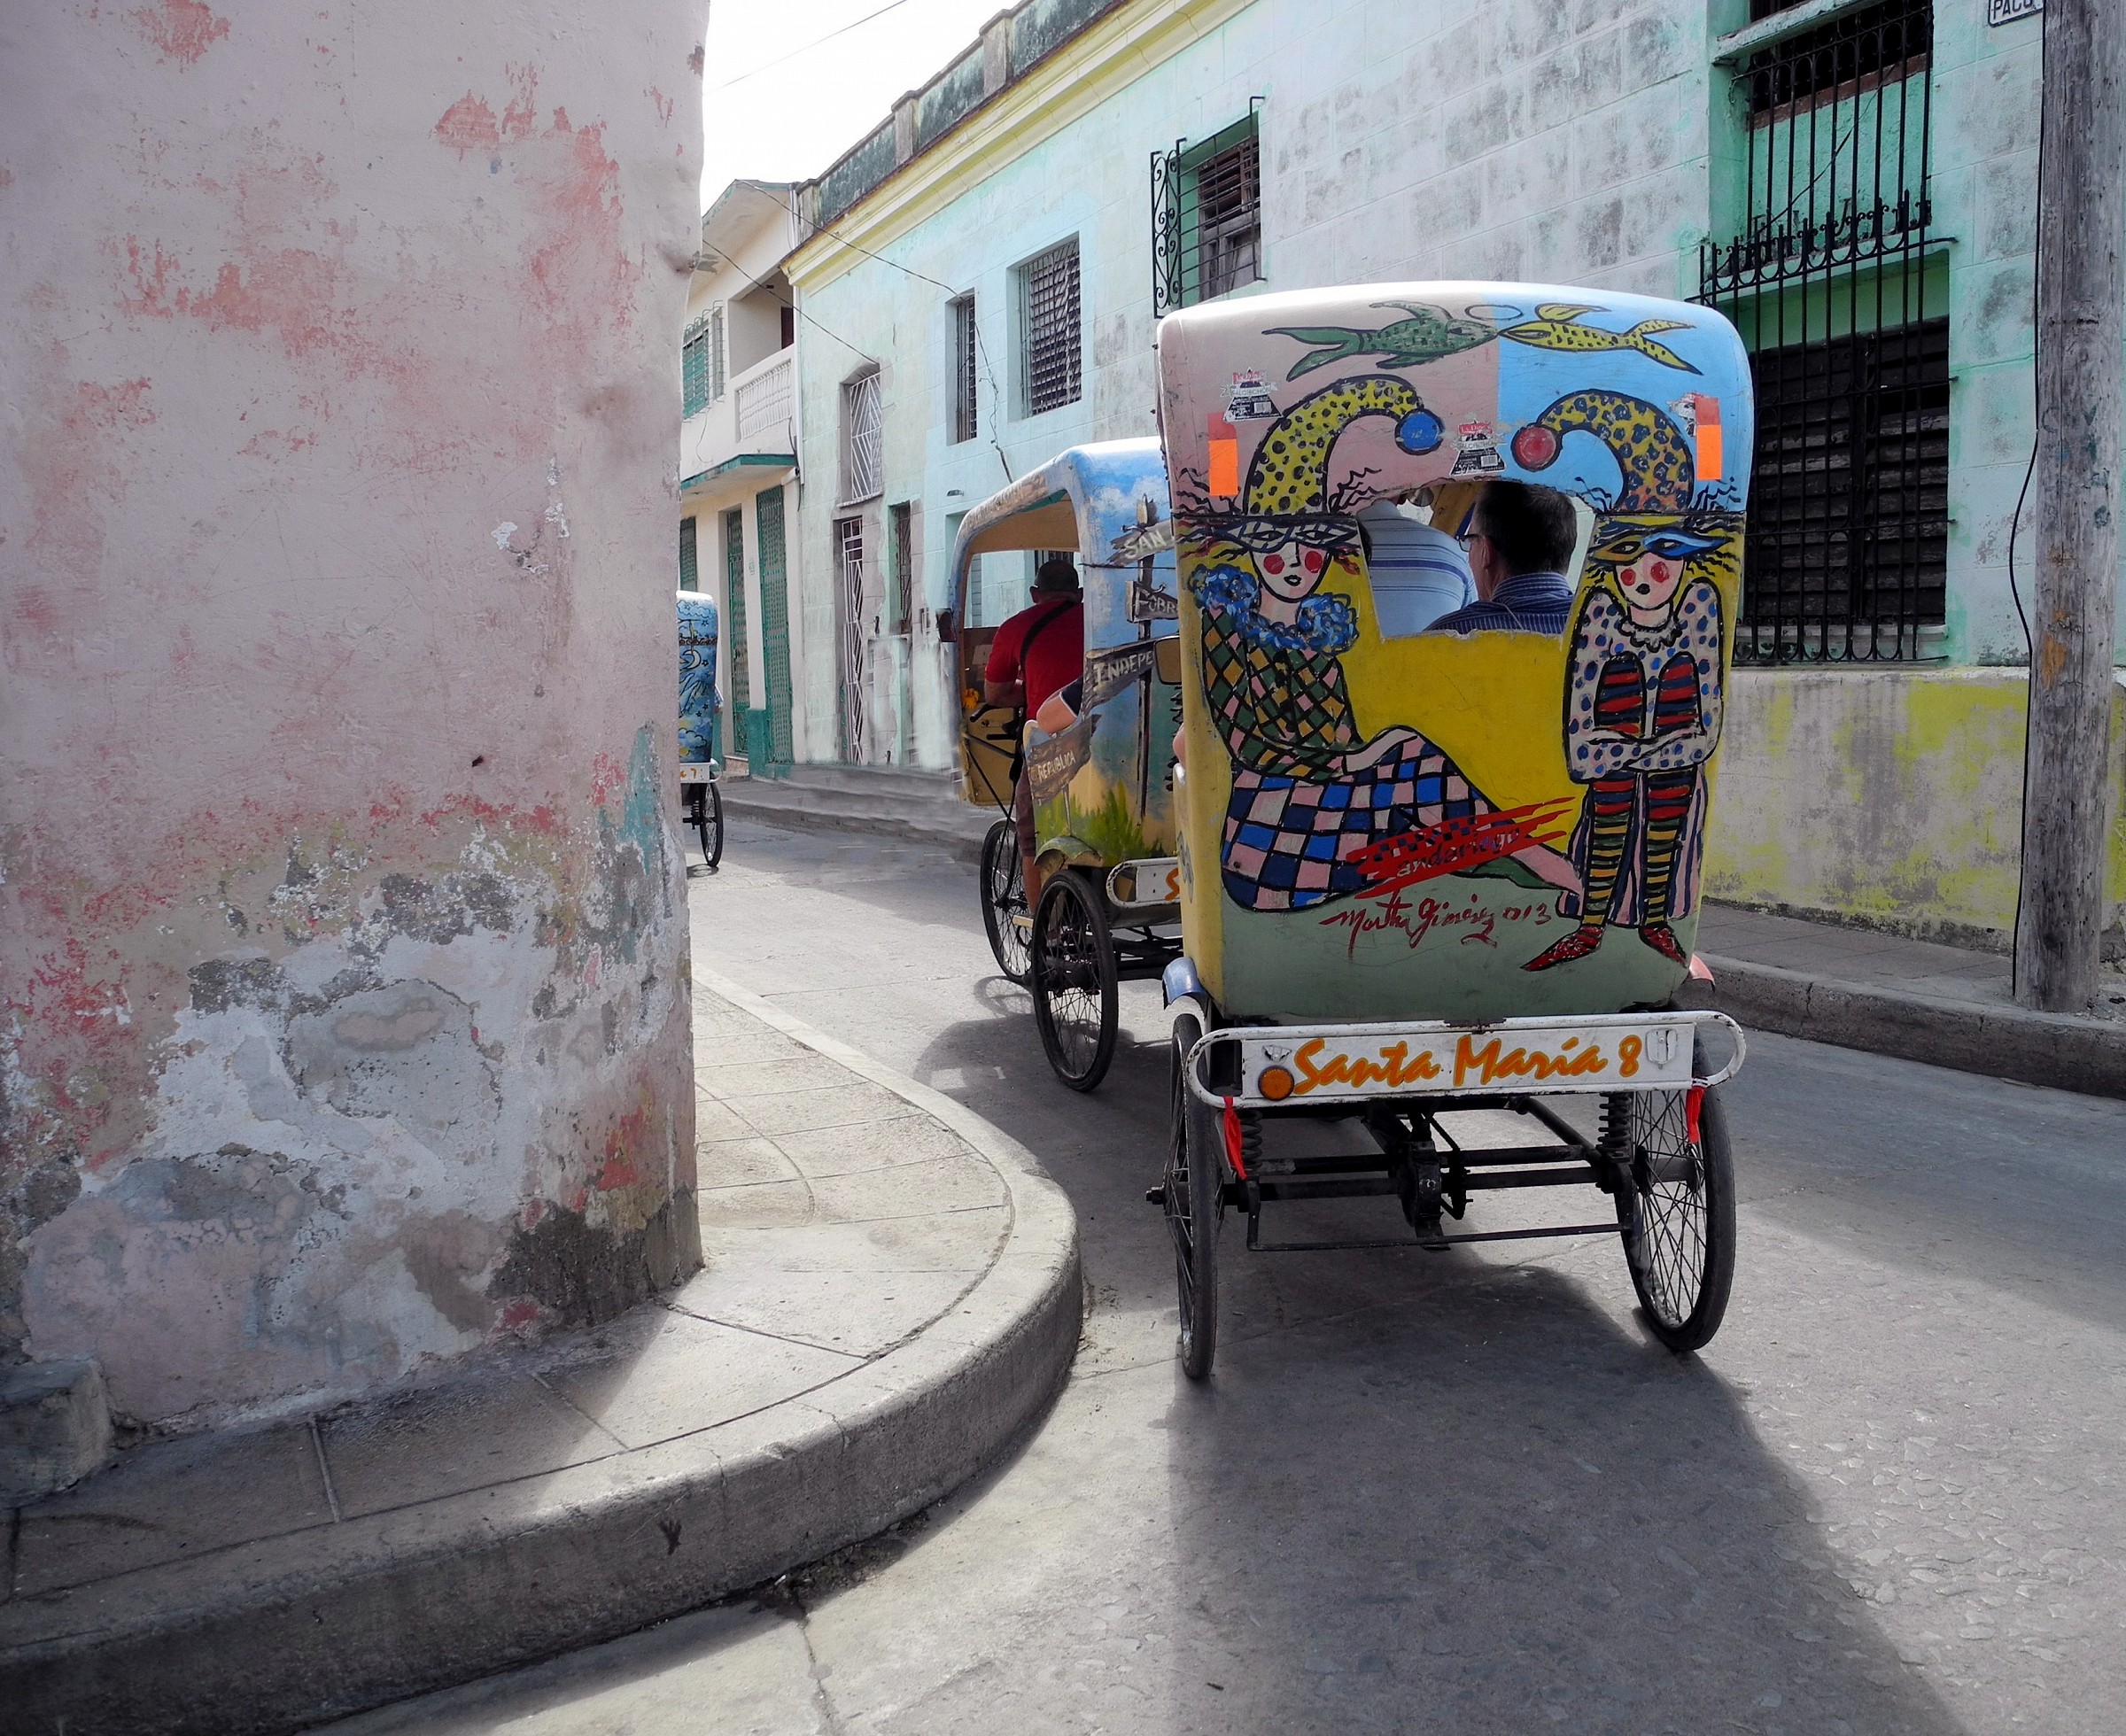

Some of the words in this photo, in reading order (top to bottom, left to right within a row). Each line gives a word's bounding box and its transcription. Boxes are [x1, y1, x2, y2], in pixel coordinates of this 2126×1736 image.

[1123, 530, 1168, 560] SAN
[1093, 651, 1153, 692] INDEPE
[1293, 1037, 1442, 1095] Santa
[1454, 1035, 1609, 1087] María
[1619, 1035, 1643, 1078] 8
